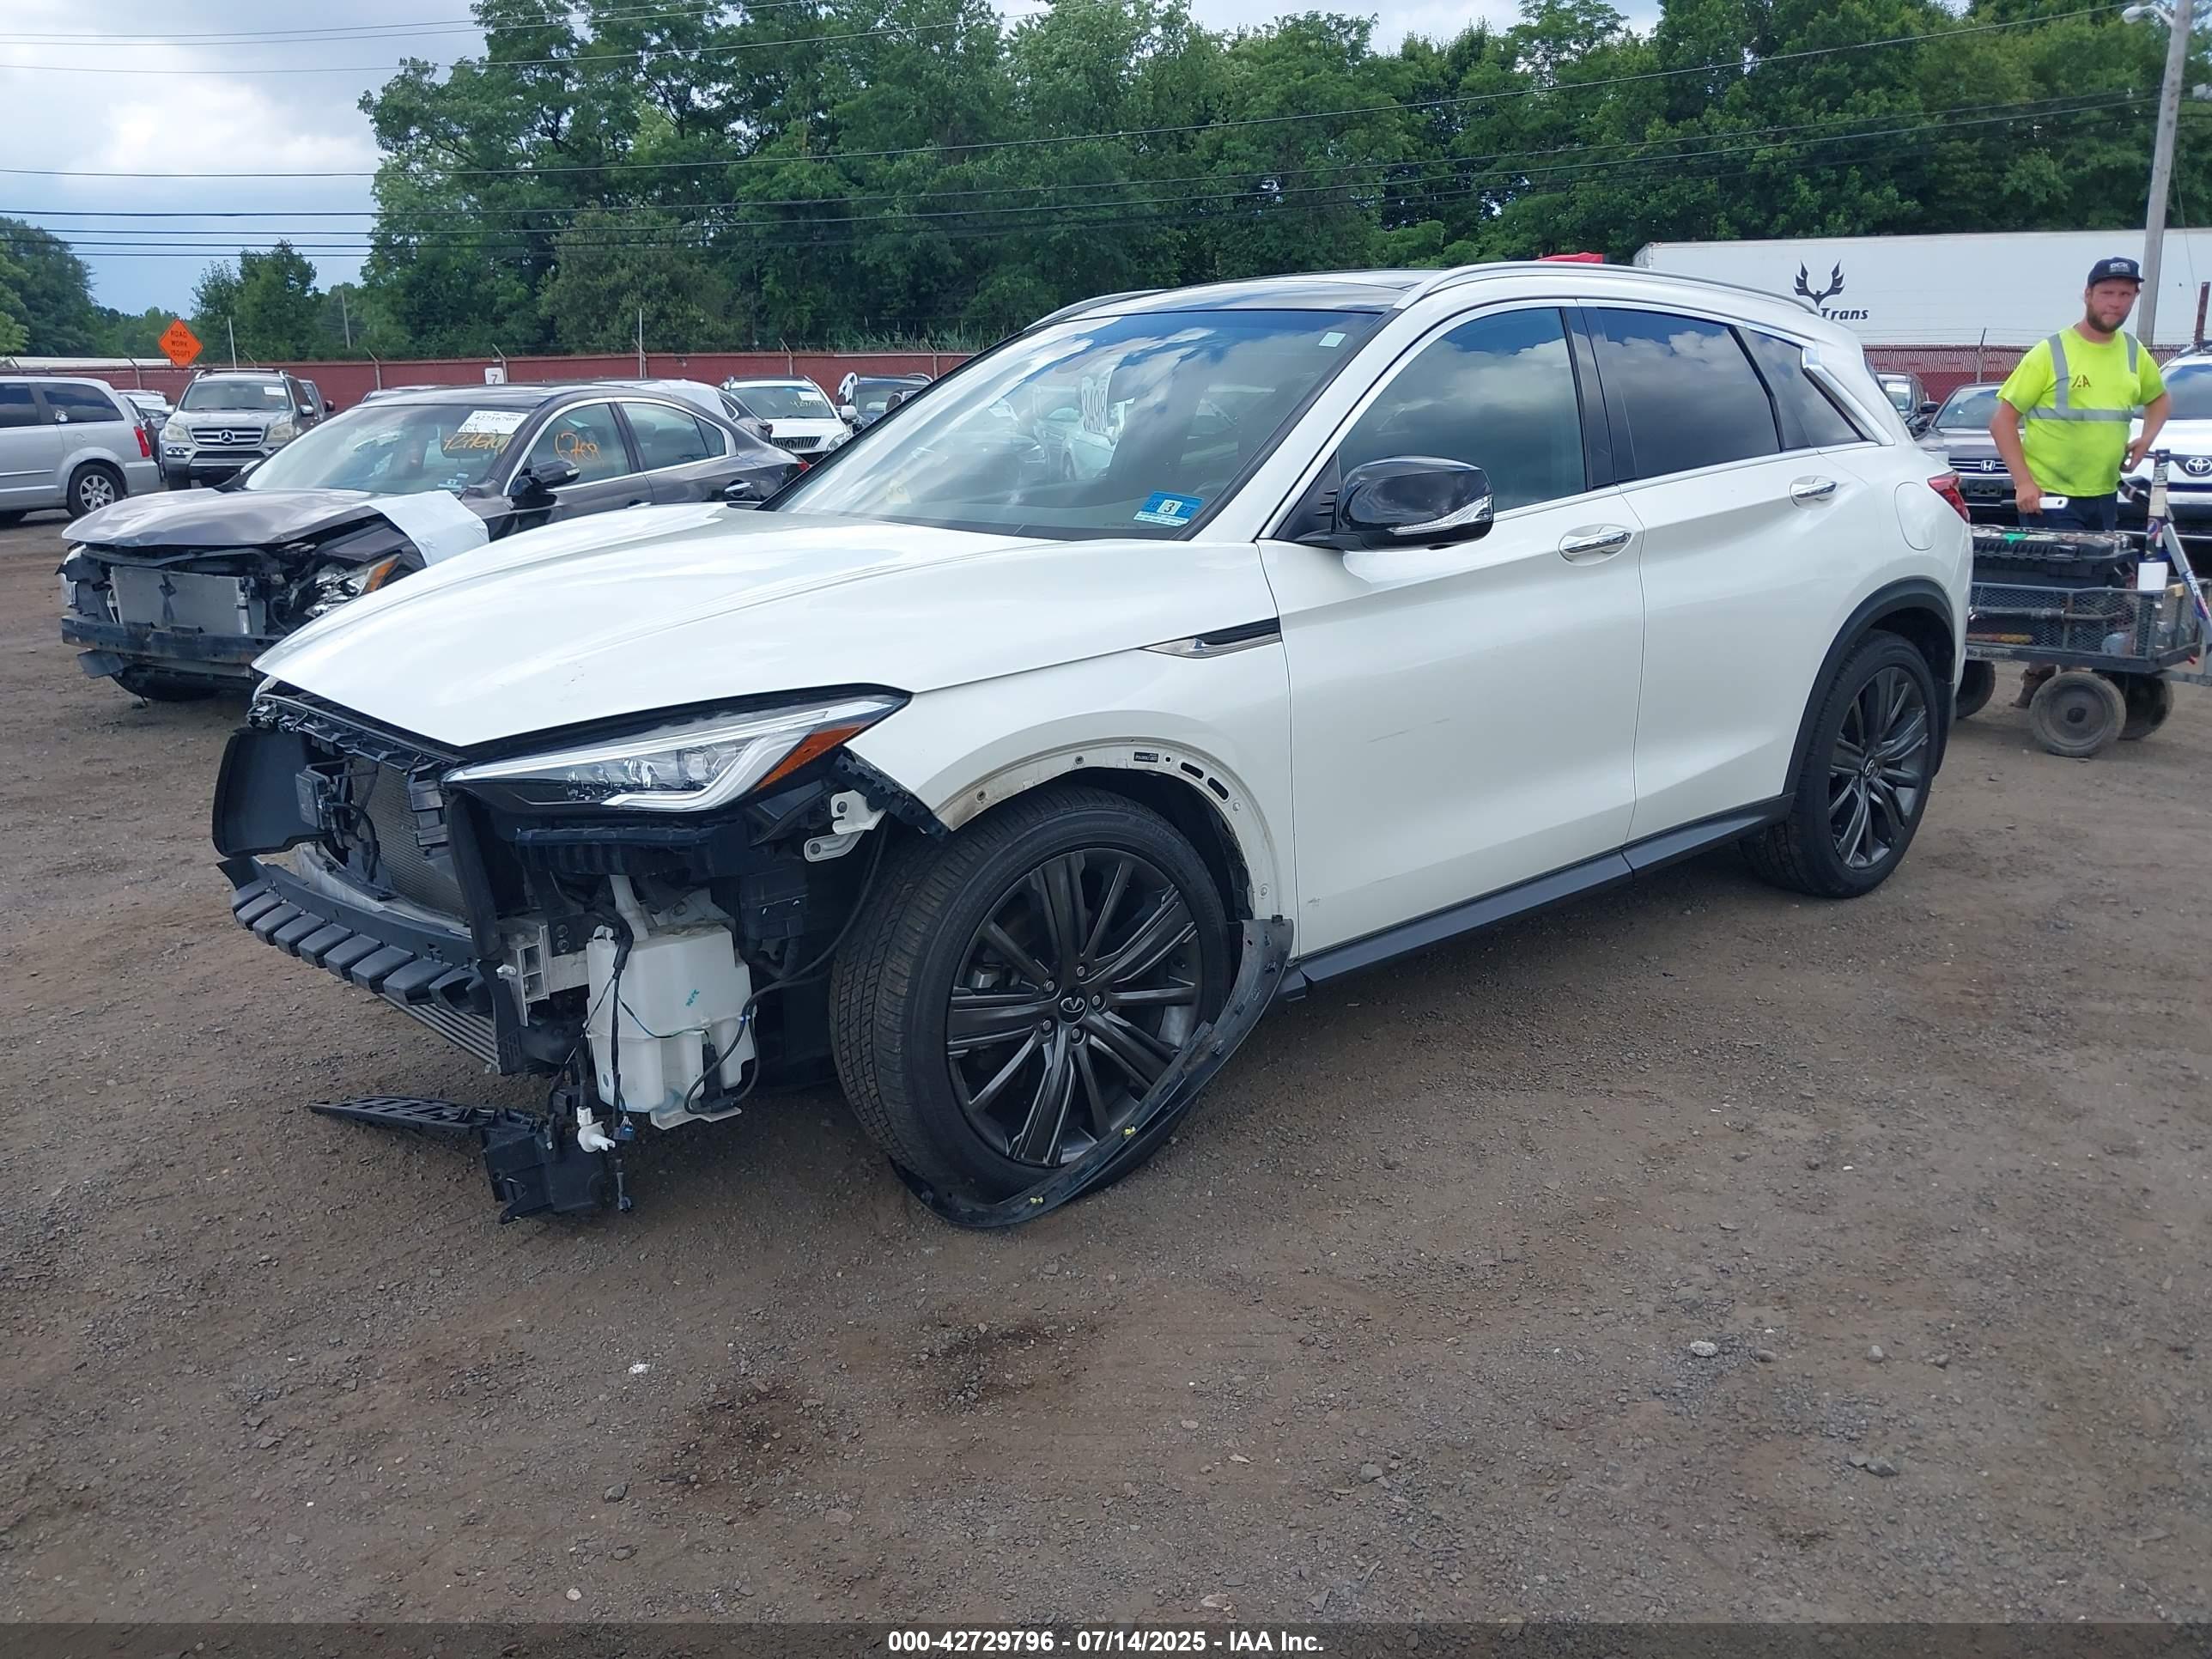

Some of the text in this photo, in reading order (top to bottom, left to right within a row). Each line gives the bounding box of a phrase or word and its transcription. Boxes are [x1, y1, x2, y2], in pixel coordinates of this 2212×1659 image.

[1820, 307, 1869, 320] Trans
[170, 330, 187, 338] ROAD
[490, 374, 498, 384] 7
[1164, 501, 1176, 514] 3
